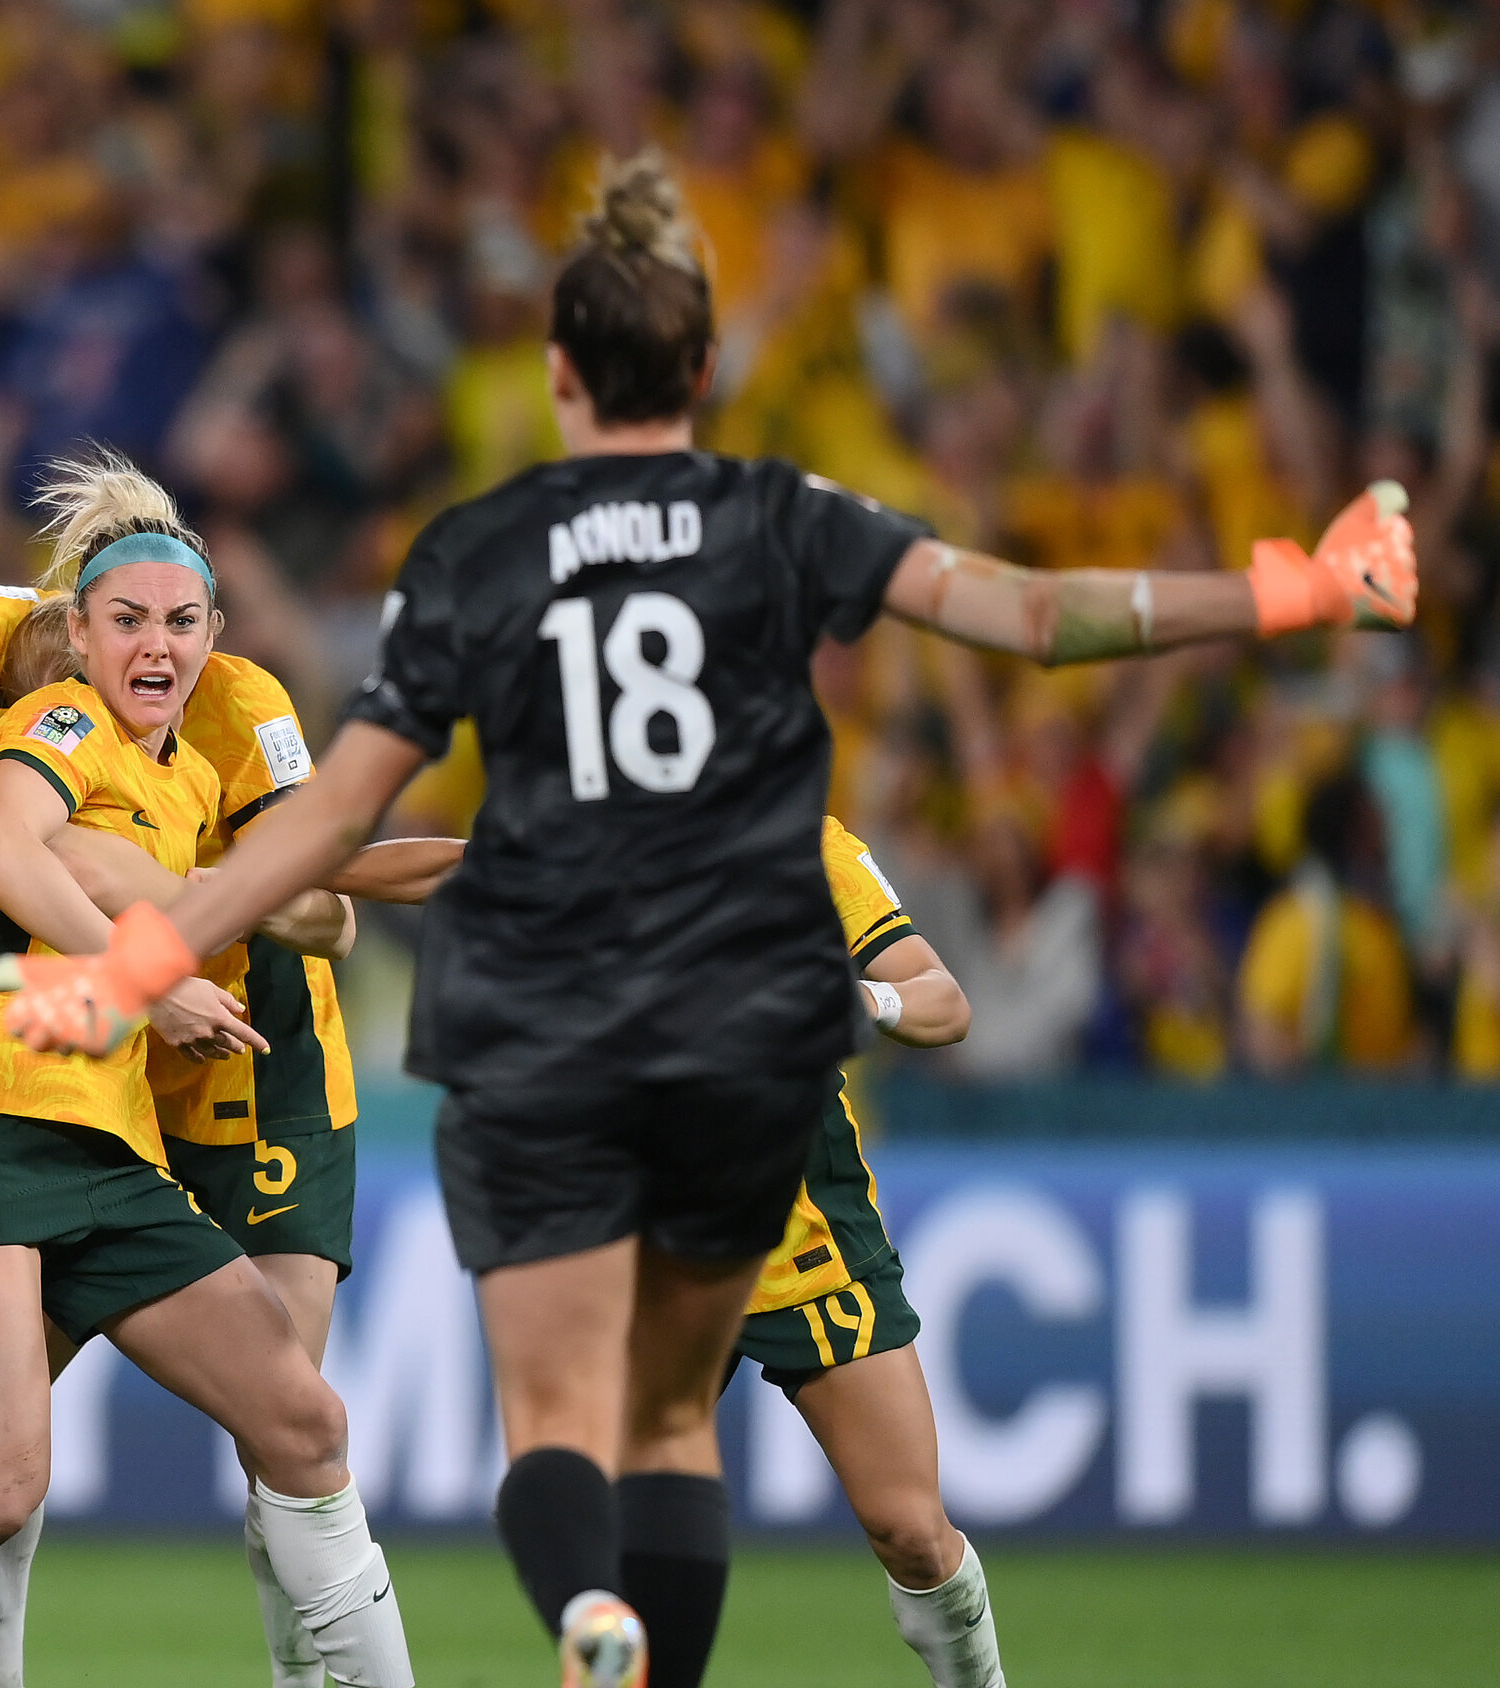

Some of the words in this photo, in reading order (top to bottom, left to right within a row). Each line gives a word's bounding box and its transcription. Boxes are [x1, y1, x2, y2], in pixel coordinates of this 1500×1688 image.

[548, 500, 703, 584] ARNOLD
[537, 591, 716, 802] 18
[253, 1139, 297, 1194] 5
[793, 1280, 876, 1367] 19
